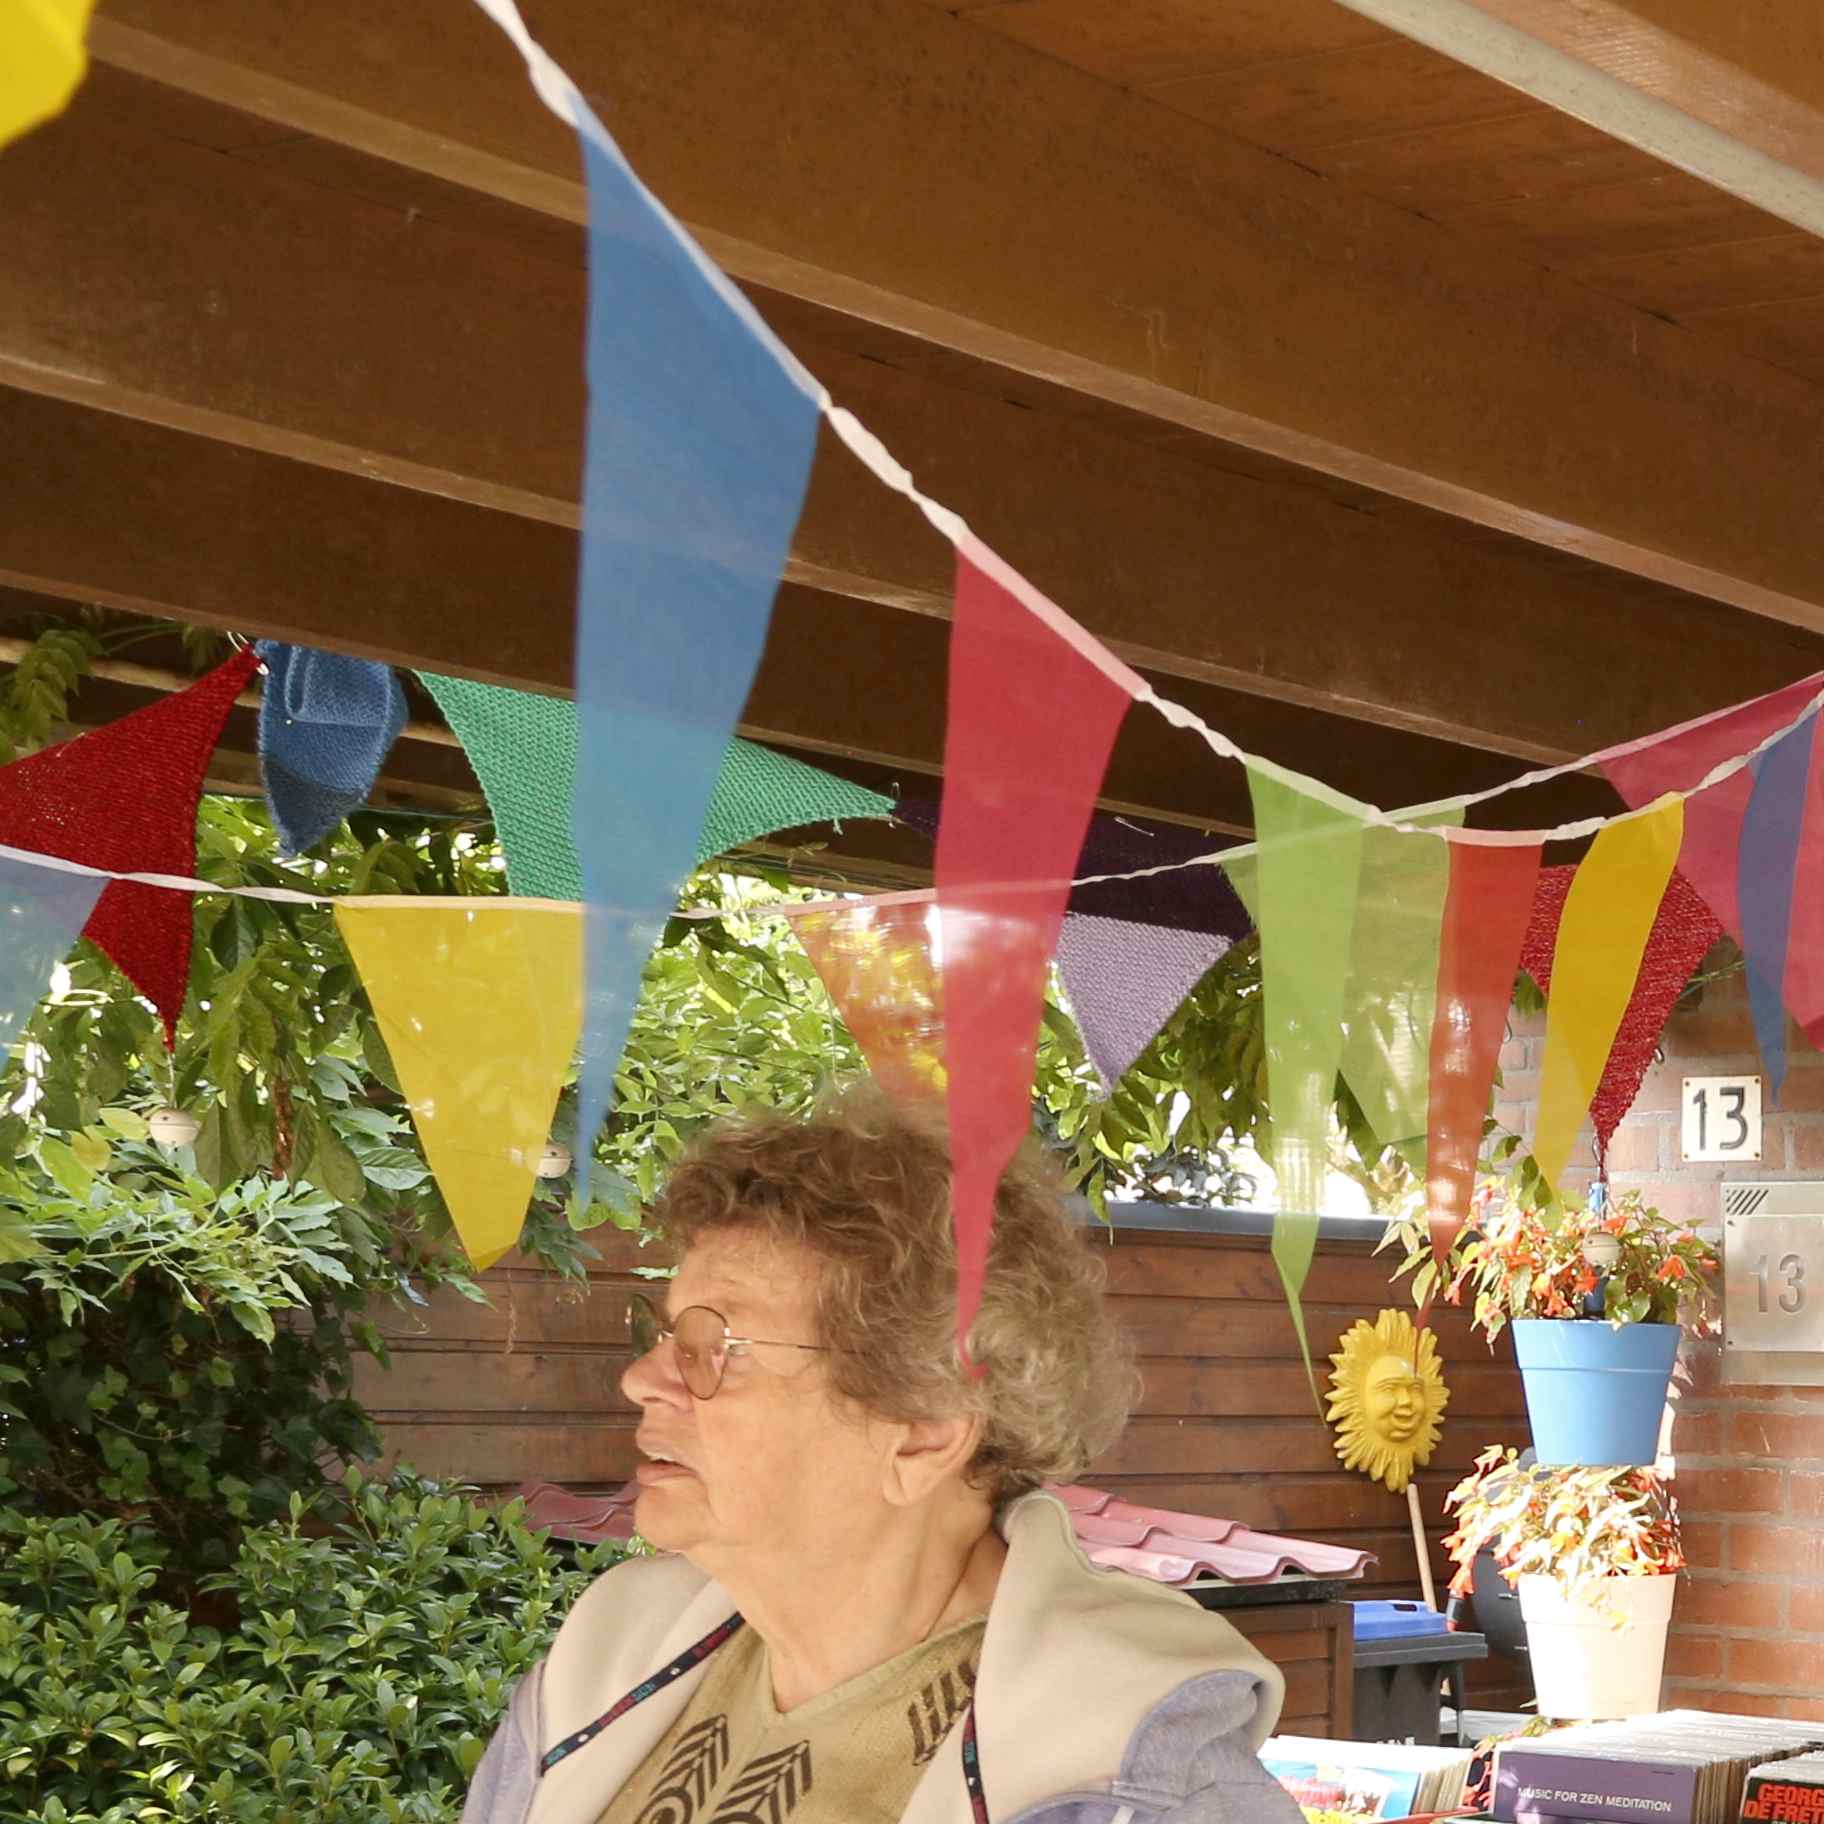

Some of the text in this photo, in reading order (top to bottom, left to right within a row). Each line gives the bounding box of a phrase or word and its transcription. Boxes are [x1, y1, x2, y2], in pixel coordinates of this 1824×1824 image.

[1692, 1086, 1749, 1151] 13
[1755, 1253, 1804, 1312] 13
[1519, 1787, 1671, 1812] MUSIC FOR ZEN MEDITATION
[1744, 1801, 1771, 1819] DE
